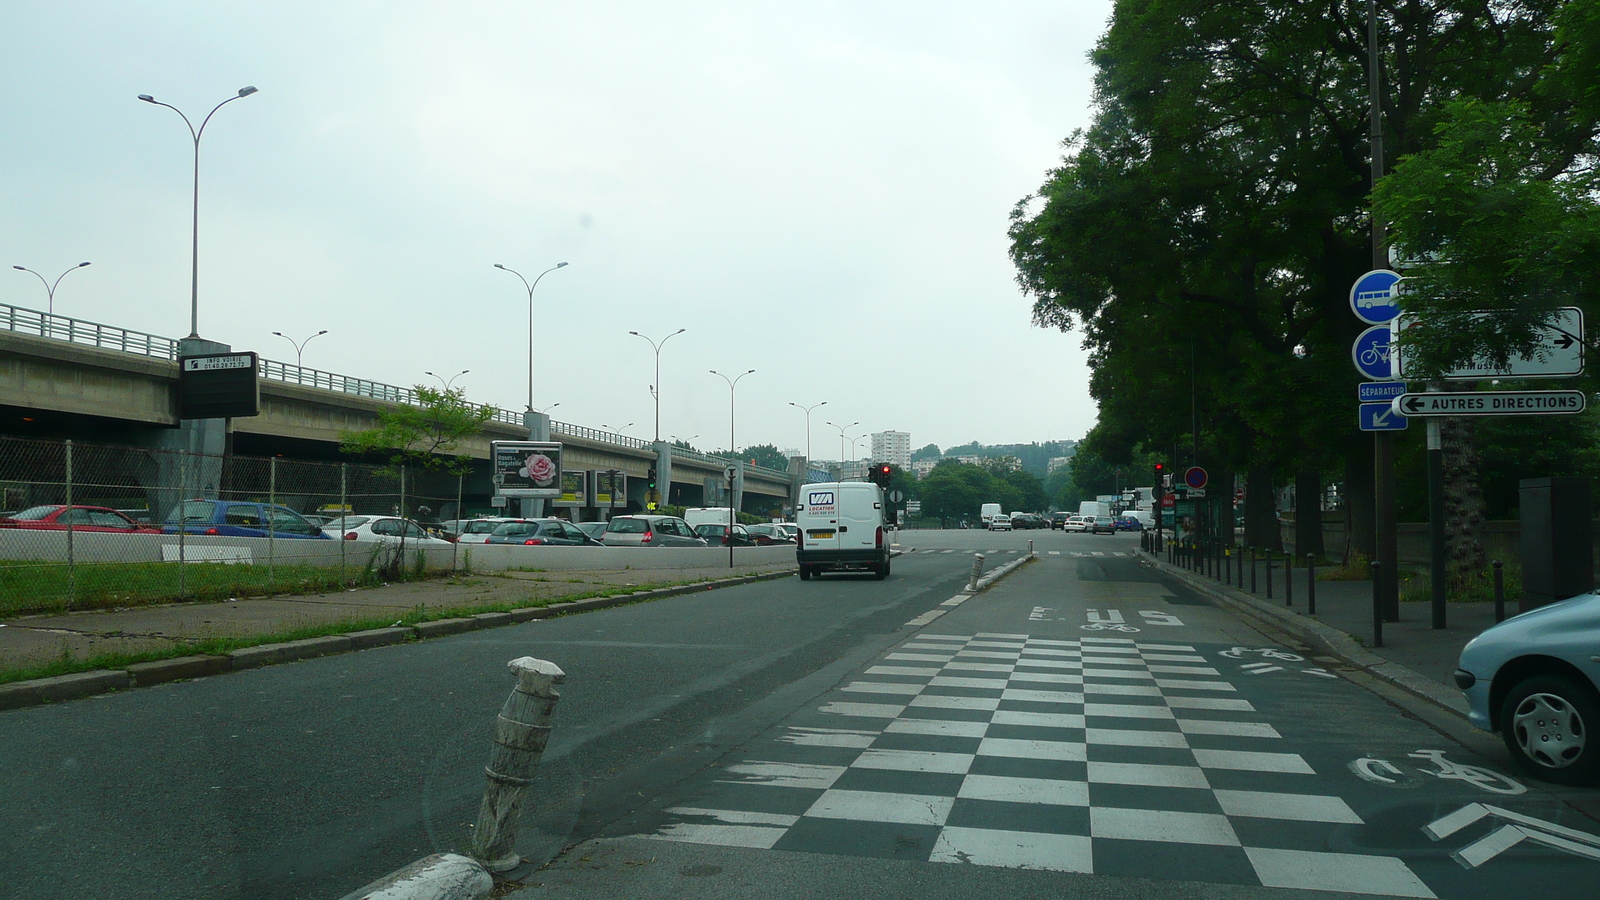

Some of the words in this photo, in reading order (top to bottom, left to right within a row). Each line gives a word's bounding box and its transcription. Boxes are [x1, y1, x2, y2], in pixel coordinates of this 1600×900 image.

[1361, 386, 1405, 397] SÉPARATEUR
[1431, 398, 1484, 410] AUTRES
[1492, 396, 1577, 409] DIRECTIONS
[811, 494, 832, 504] VIA
